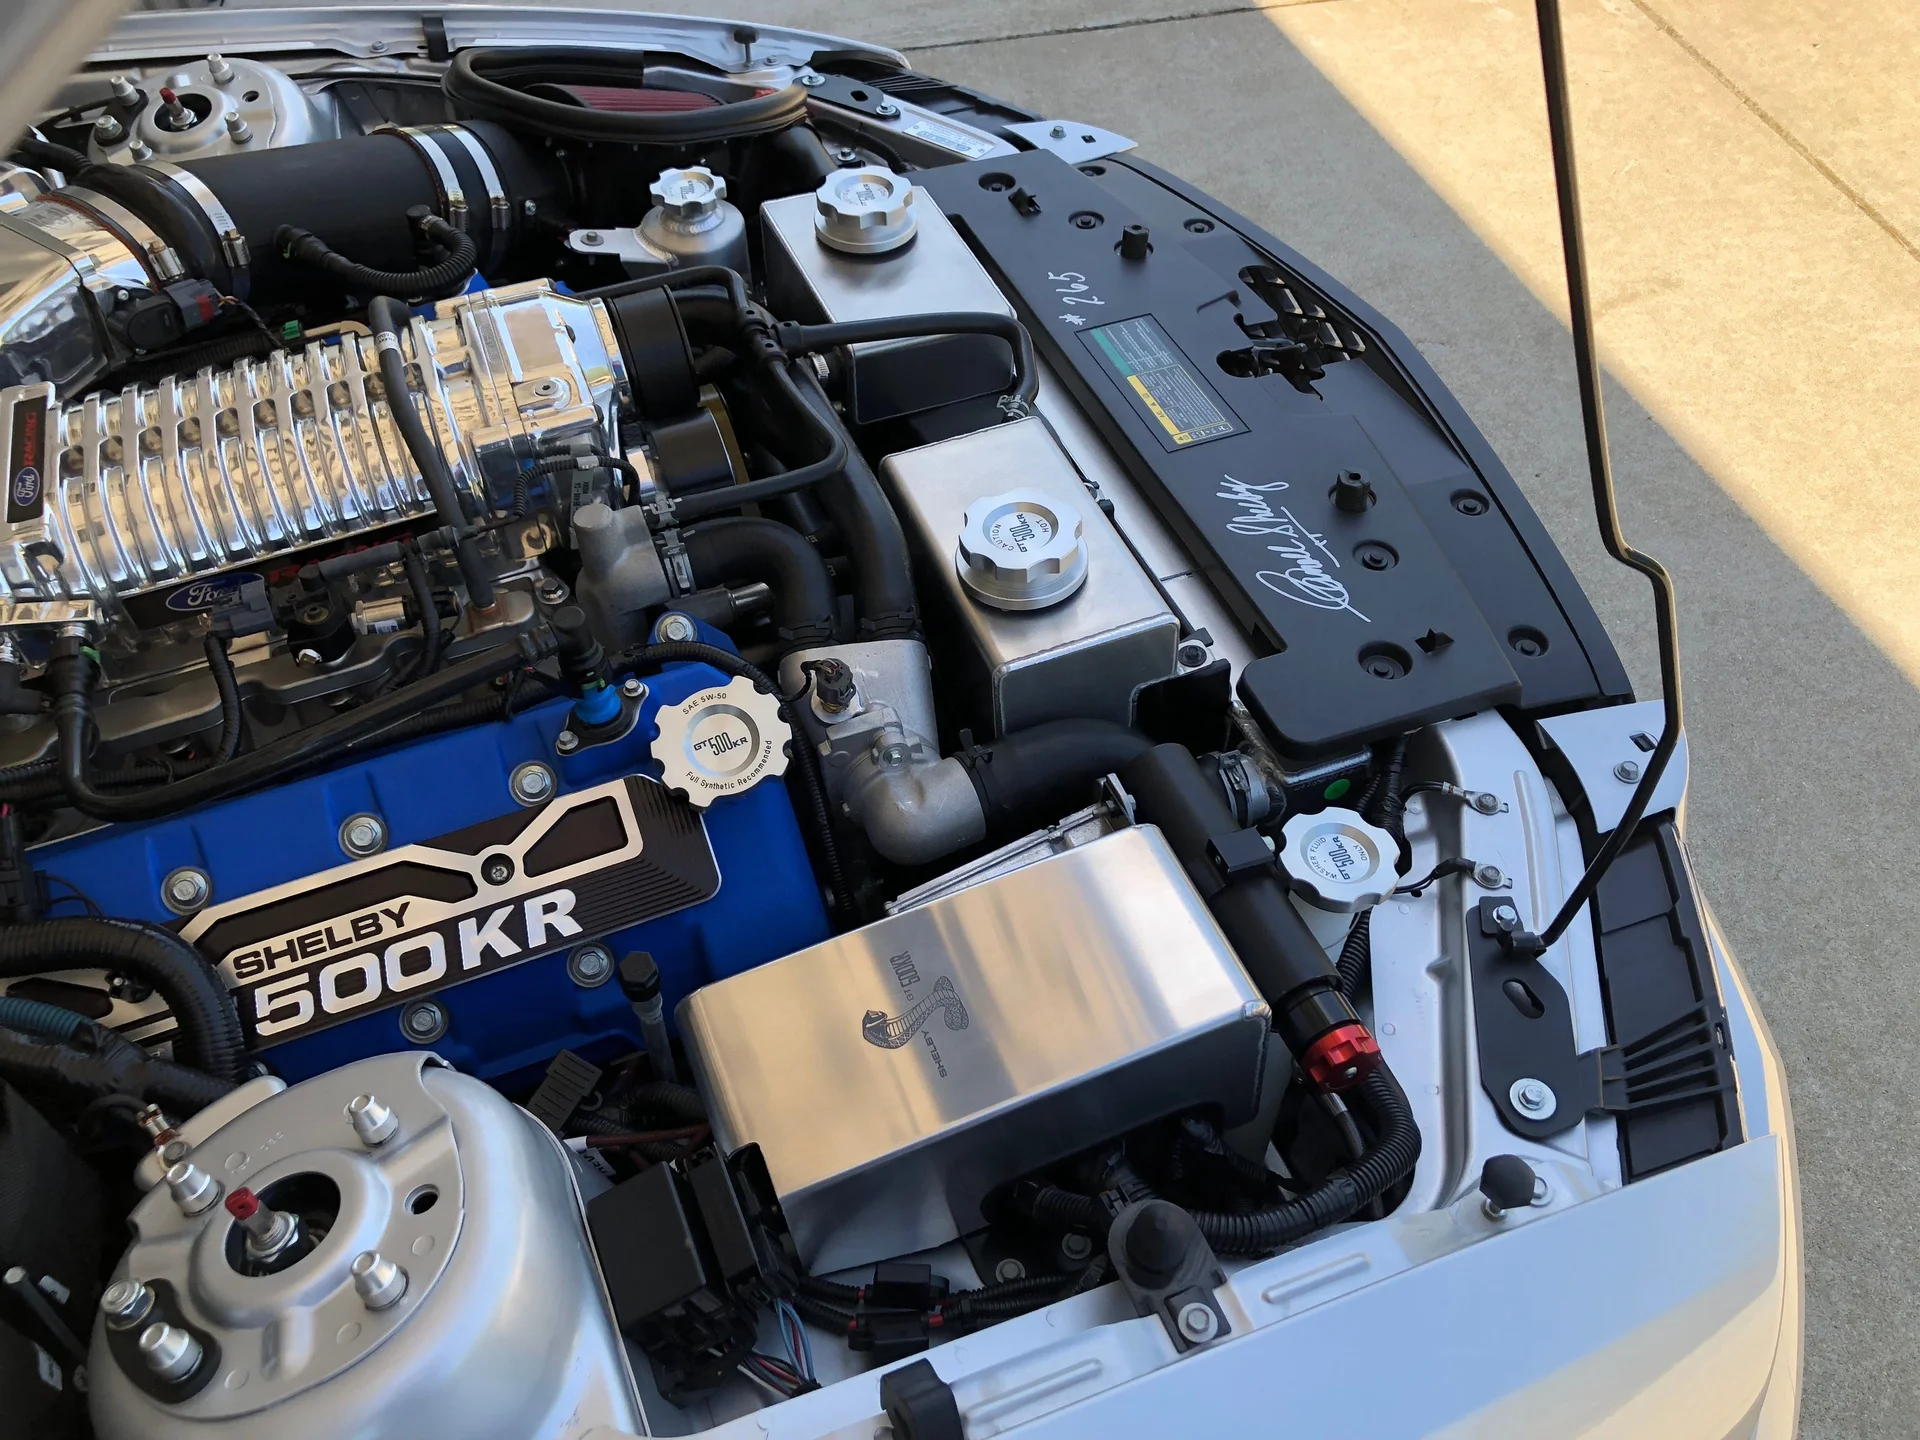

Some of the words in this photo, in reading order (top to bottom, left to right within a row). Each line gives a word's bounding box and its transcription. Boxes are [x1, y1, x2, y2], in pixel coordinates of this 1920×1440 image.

[24, 412, 37, 467] RACING
[16, 473, 36, 499] Ford
[992, 523, 1015, 551] CAUTION
[1035, 518, 1050, 533] HOT
[682, 700, 700, 715] SAE
[700, 692, 727, 703] 5W-50
[685, 771, 699, 784] Full
[700, 778, 735, 790] Synthetic
[737, 740, 773, 787] Recommended
[1309, 836, 1326, 853] FLUID
[1353, 843, 1368, 861] ONLY
[1310, 855, 1338, 880] WASHER
[233, 901, 411, 980] SHELBY
[921, 1028, 948, 1079] SHELBY
